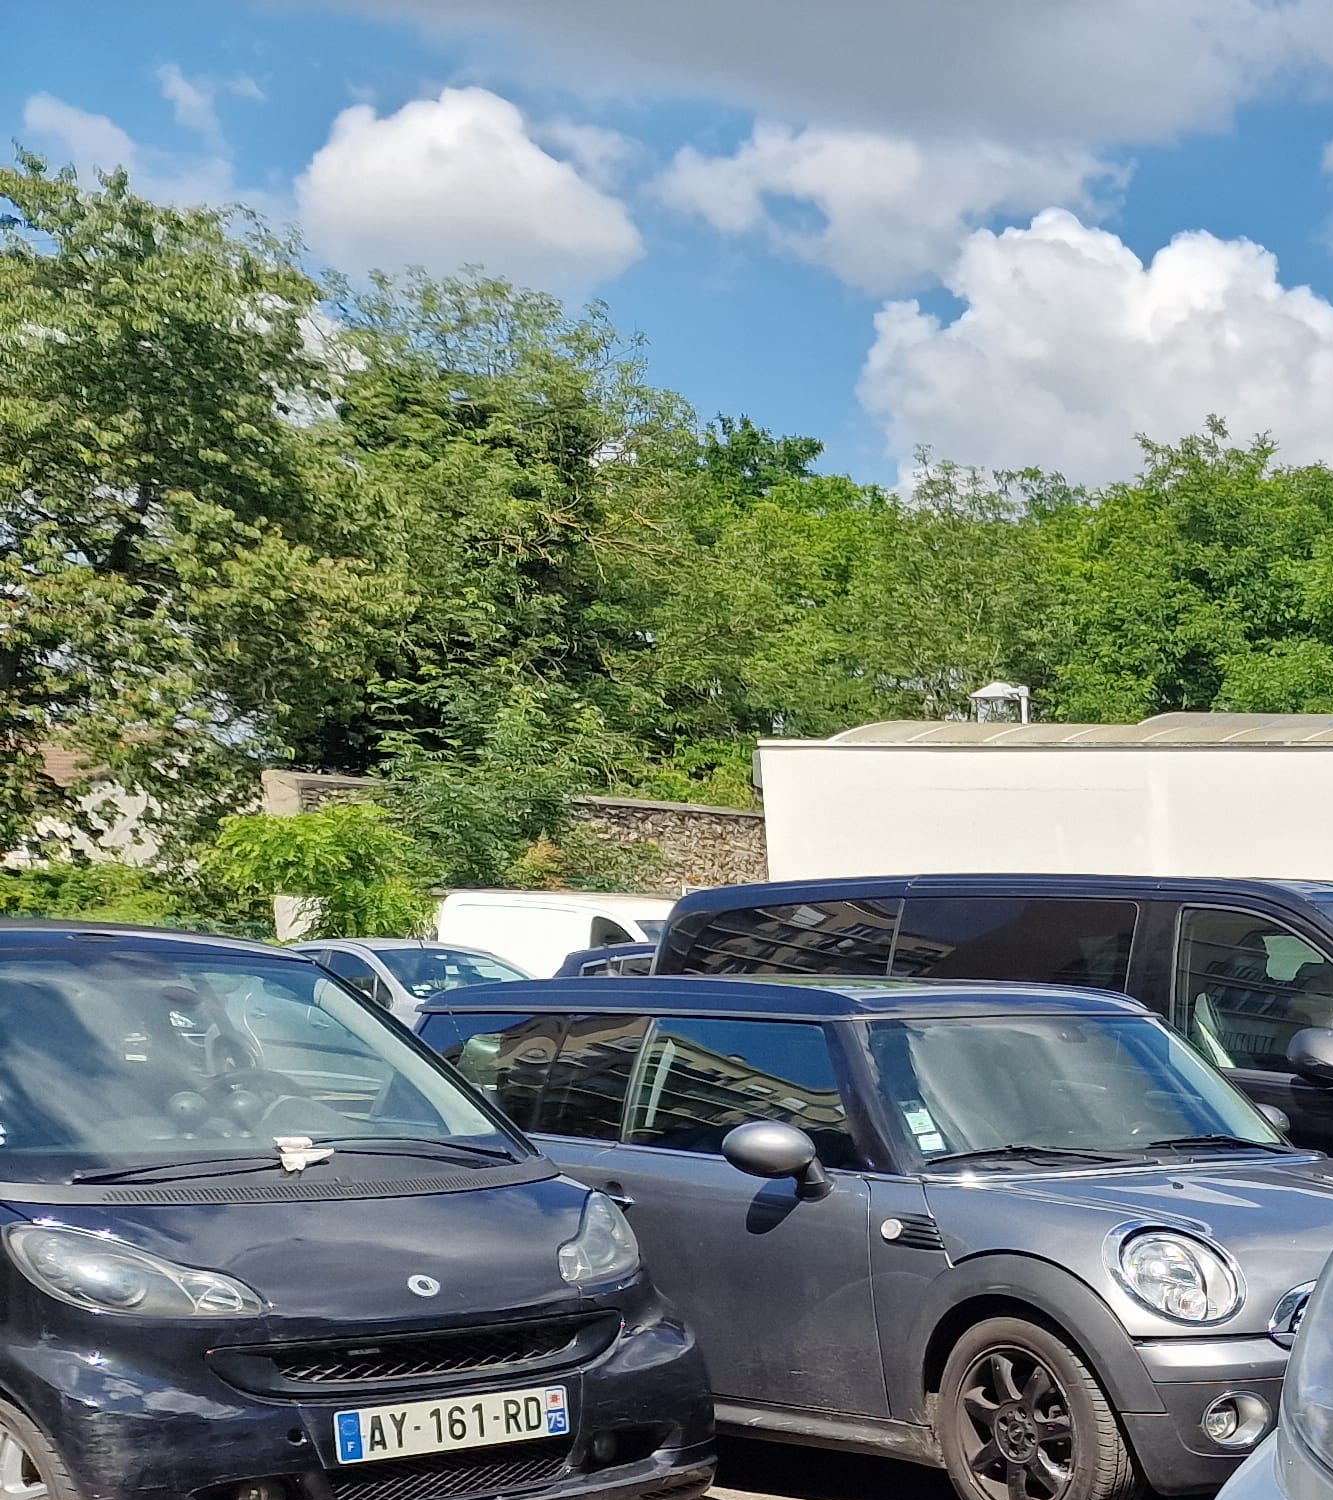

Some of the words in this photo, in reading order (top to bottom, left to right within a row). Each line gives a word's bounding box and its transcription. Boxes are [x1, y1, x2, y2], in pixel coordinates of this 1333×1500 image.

[347, 1442, 355, 1453] F
[369, 1396, 542, 1452] AY-161-RD
[549, 1411, 565, 1428] 75
